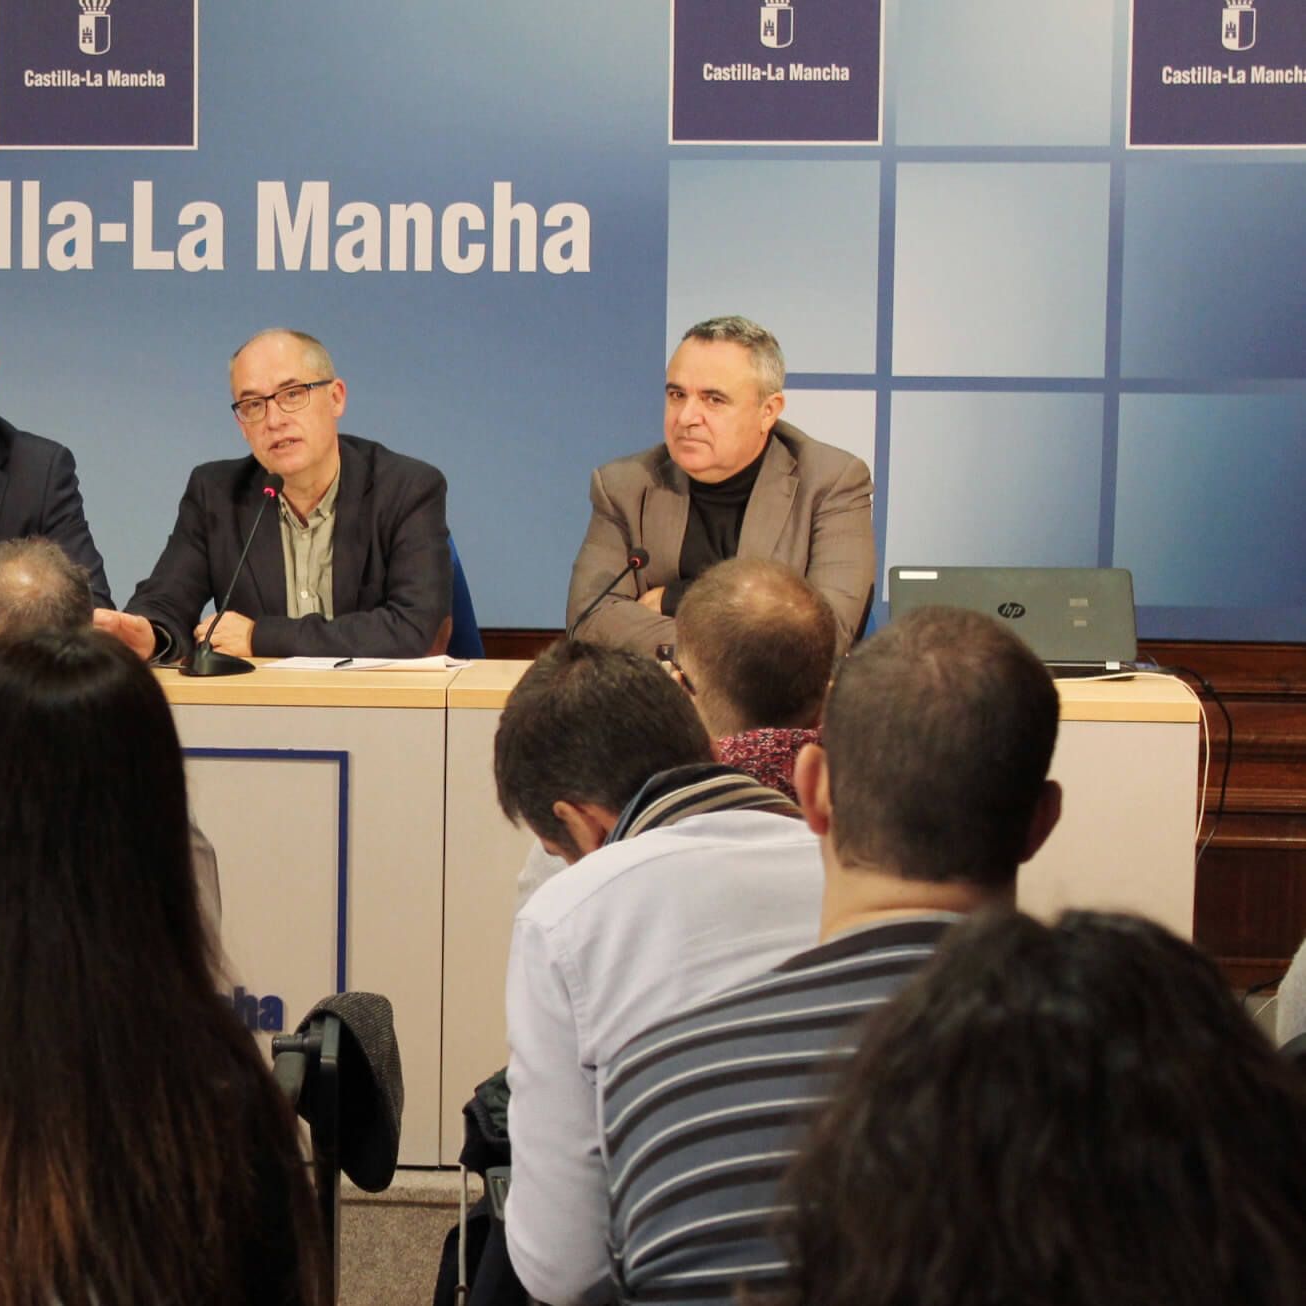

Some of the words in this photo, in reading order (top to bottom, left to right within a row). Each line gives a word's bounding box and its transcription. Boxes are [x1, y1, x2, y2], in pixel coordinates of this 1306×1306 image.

[23, 69, 103, 88] Castilla-La
[107, 69, 166, 88] Mancha
[702, 63, 785, 82] Castilla-La
[789, 63, 850, 82] Mancha
[1161, 65, 1246, 85] Castilla-La
[256, 180, 591, 274] Mancha
[999, 602, 1024, 619] hp
